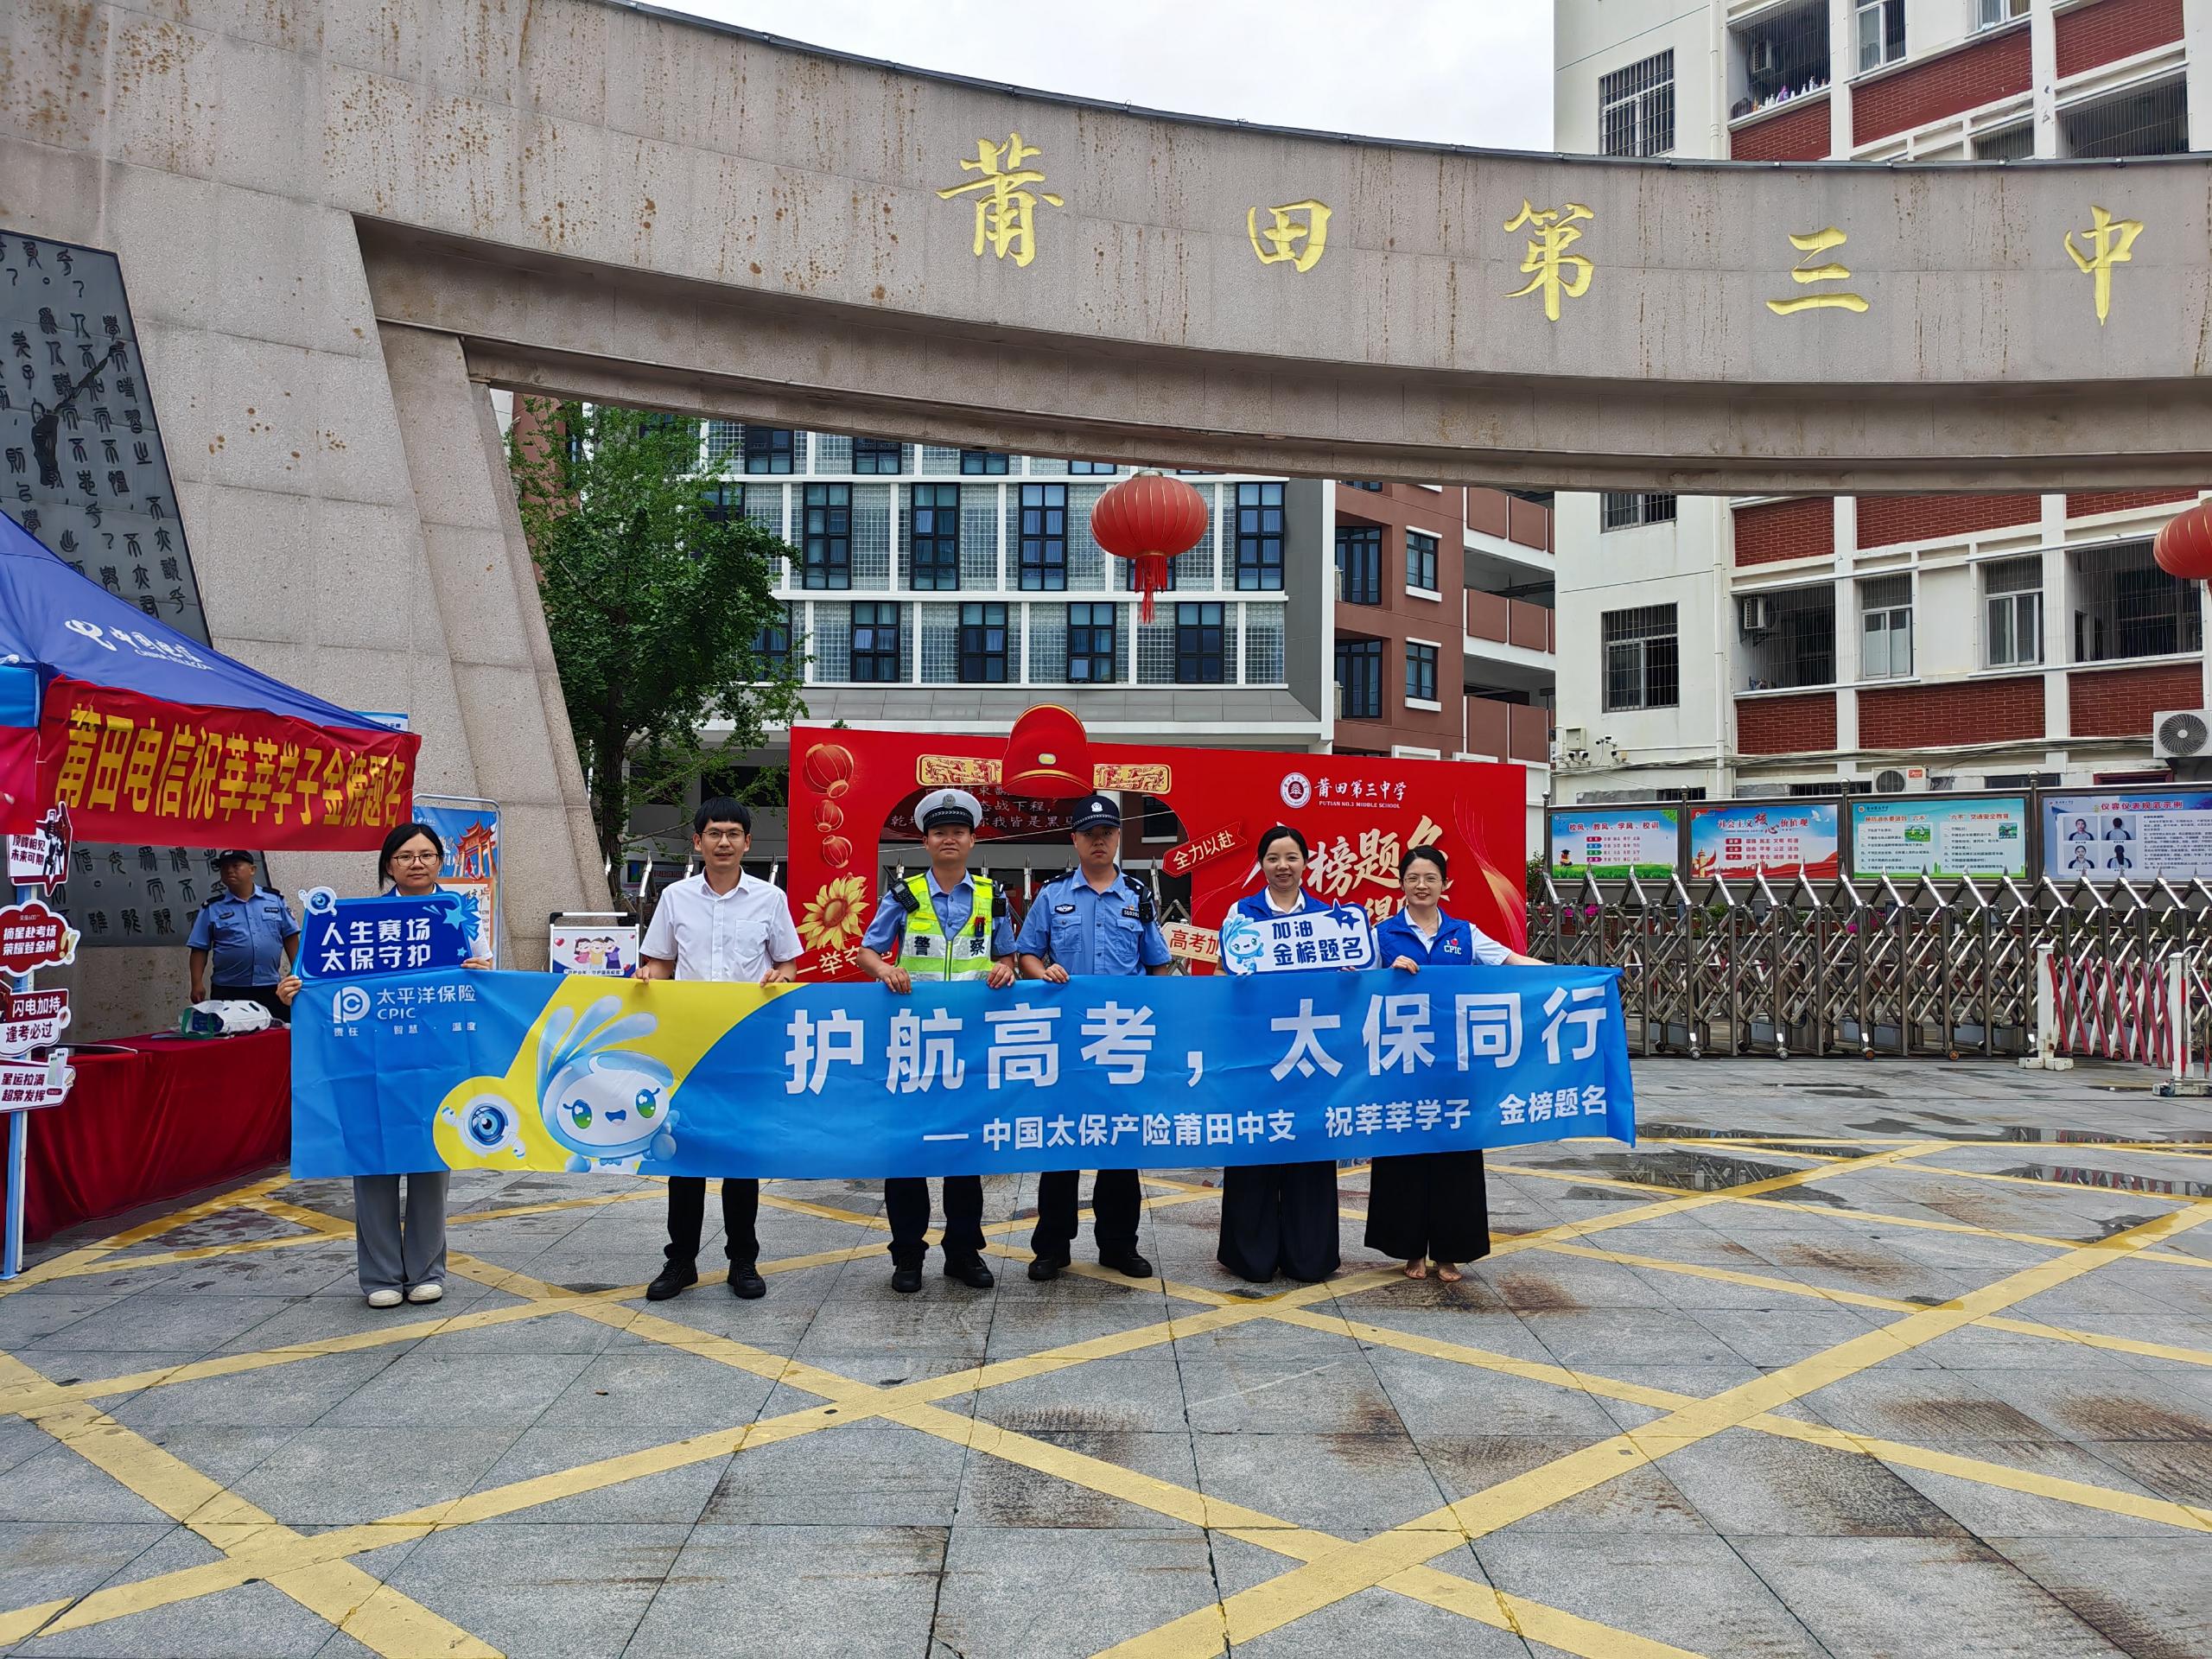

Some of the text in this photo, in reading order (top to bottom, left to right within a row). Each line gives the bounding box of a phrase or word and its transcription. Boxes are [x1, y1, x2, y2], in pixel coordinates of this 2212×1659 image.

[55, 703, 407, 828] 莆田电信祝莘莘学子金榜题名
[1314, 778, 1407, 801] 莆田第三中学
[2101, 801, 2183, 810] 仪容仪表规范示例
[1569, 821, 1660, 831] 校风、教风、学风、校训
[1718, 812, 1808, 834] 社会主义核心价值观
[11, 849, 45, 866] 未来可期
[1173, 830, 1236, 870] 全力以赴
[3, 925, 57, 941] 摘星赴考场
[321, 918, 430, 946] 人生赛场
[1272, 920, 1313, 940] 加油
[3, 939, 56, 956] 荣耀登金榜
[914, 936, 985, 956] 警 察
[1273, 937, 1363, 966] 金榜题名
[1444, 945, 1462, 955] CPIC
[321, 944, 431, 972] 太保守护
[377, 985, 476, 1005] 太平洋保险
[12, 995, 60, 1018] 闪电加持
[377, 1007, 416, 1020] CPIC
[6, 1022, 52, 1043] 逢考必过
[334, 1027, 359, 1037] 责任
[393, 1025, 418, 1035] 智慧
[785, 985, 1607, 1095] 护航高考，太保同行
[2, 1073, 45, 1086] 星运拉满
[2, 1090, 45, 1102] 超常发挥
[982, 1109, 1296, 1151] 中国太保产险莆田中支
[1325, 1098, 1471, 1138] 祝莘莘学子
[1498, 1084, 1607, 1126] 金榜题名
